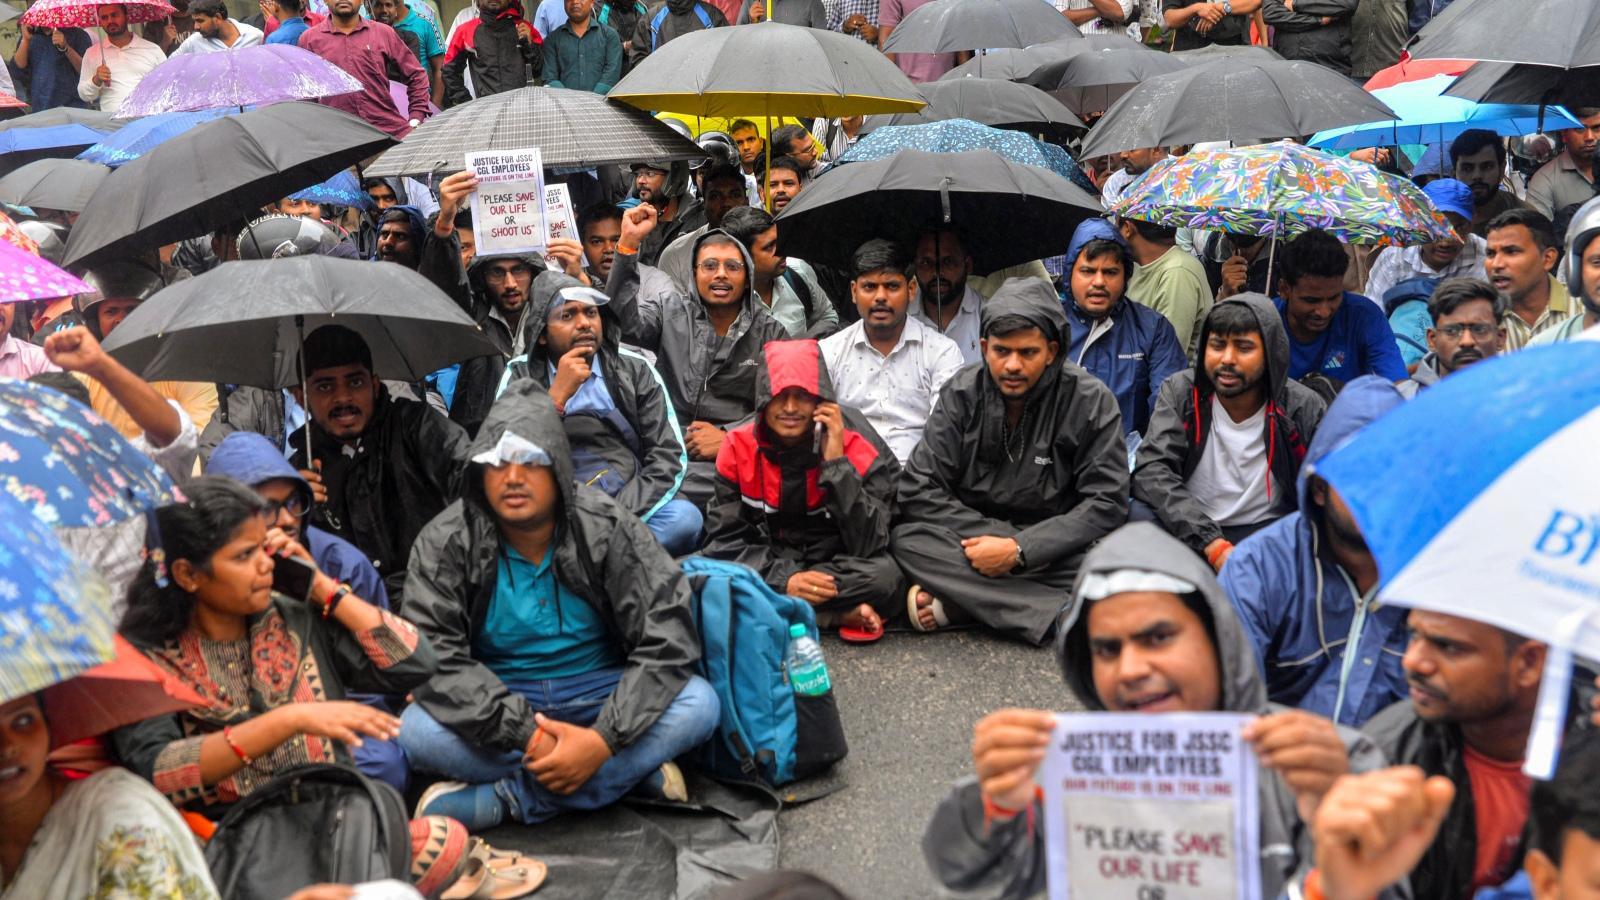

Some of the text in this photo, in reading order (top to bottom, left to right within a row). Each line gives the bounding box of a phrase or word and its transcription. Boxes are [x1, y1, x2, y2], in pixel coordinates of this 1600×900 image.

[473, 154, 533, 166] JUSTICE FOR JSSC
[477, 163, 531, 175] CGL EMPLOYEES
[480, 192, 535, 204] "PLEASE SAVE
[547, 189, 561, 197] JSSC
[490, 204, 527, 215] OUR LIFE
[504, 216, 516, 225] OR
[550, 221, 567, 232] SAVE
[491, 225, 535, 238] SHOOT US"
[1061, 731, 1232, 753] JUSTICE FOR JSSC
[1072, 755, 1222, 777] CGL EMPLOYEES
[1179, 782, 1200, 794] THE
[1173, 831, 1227, 858] SAVE
[1099, 856, 1201, 887] OUR LIFE
